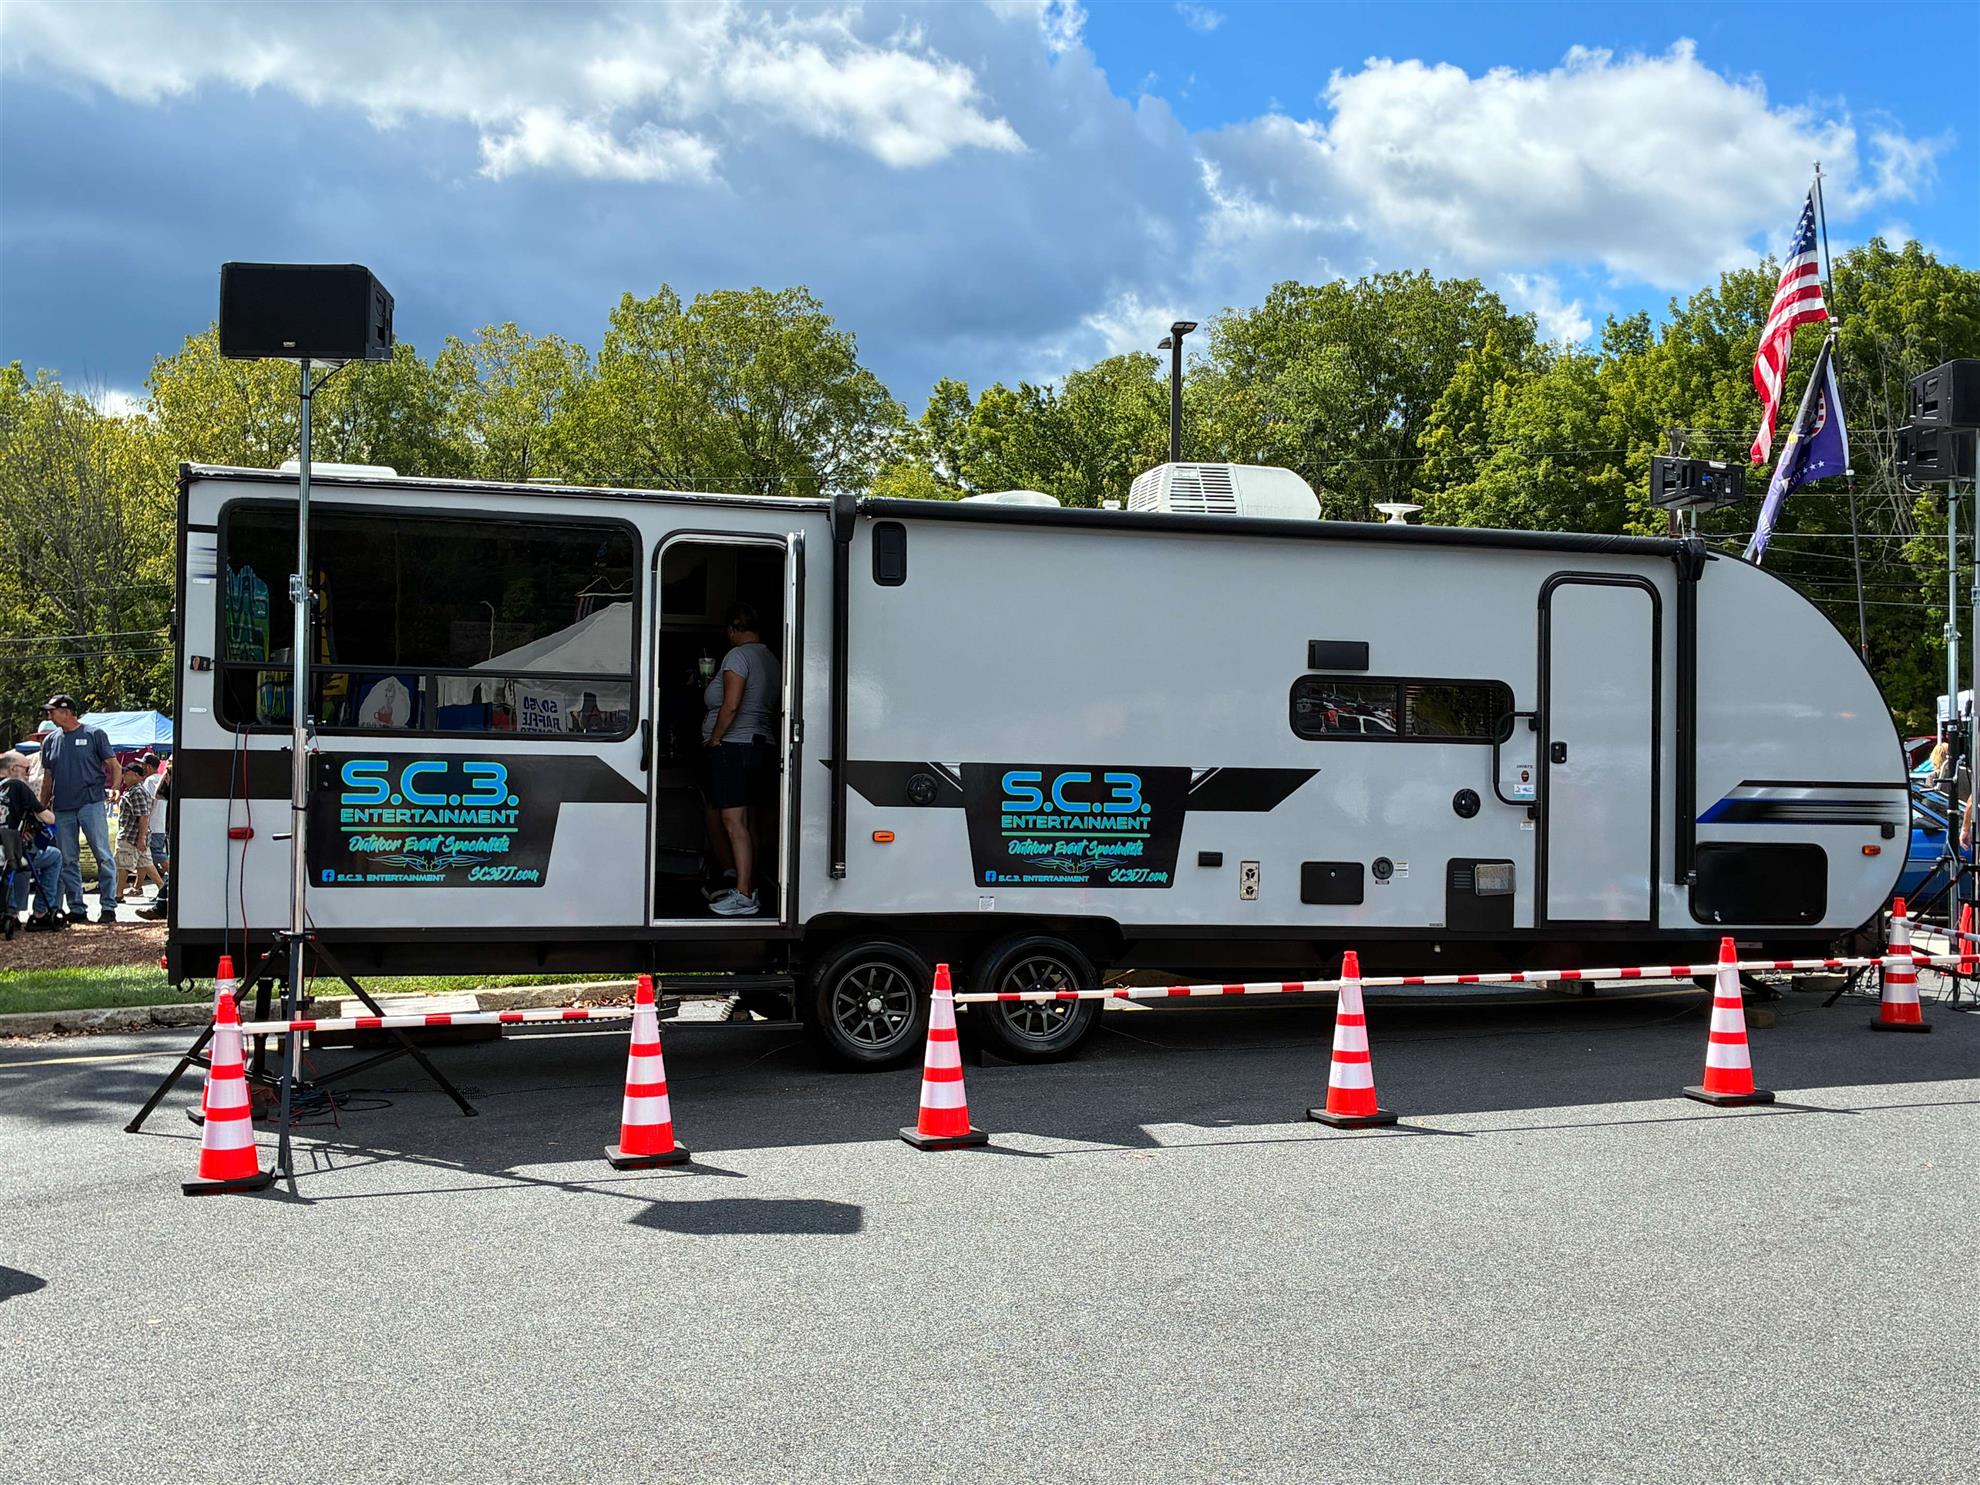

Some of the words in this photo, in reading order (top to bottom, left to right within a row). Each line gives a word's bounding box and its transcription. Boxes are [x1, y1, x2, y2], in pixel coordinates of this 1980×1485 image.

[341, 759, 519, 805] S.C.3.
[1001, 771, 1151, 814] S.C.3.
[340, 808, 519, 824] ENTERTAINMENT
[1001, 815, 1151, 830] ENTERTAINMENT
[349, 834, 402, 853] Outdoor
[403, 834, 445, 854] Event
[441, 834, 510, 857] Specialists
[1008, 838, 1053, 856] Outdoor
[1054, 839, 1090, 857] Event
[1086, 839, 1144, 860] Specialists
[366, 874, 446, 882] ENTERTAINMENT
[467, 866, 540, 883] SC3DJ.com
[1022, 875, 1090, 883] ENTERTAINMENT
[1108, 868, 1169, 884] SC3DJ.com
